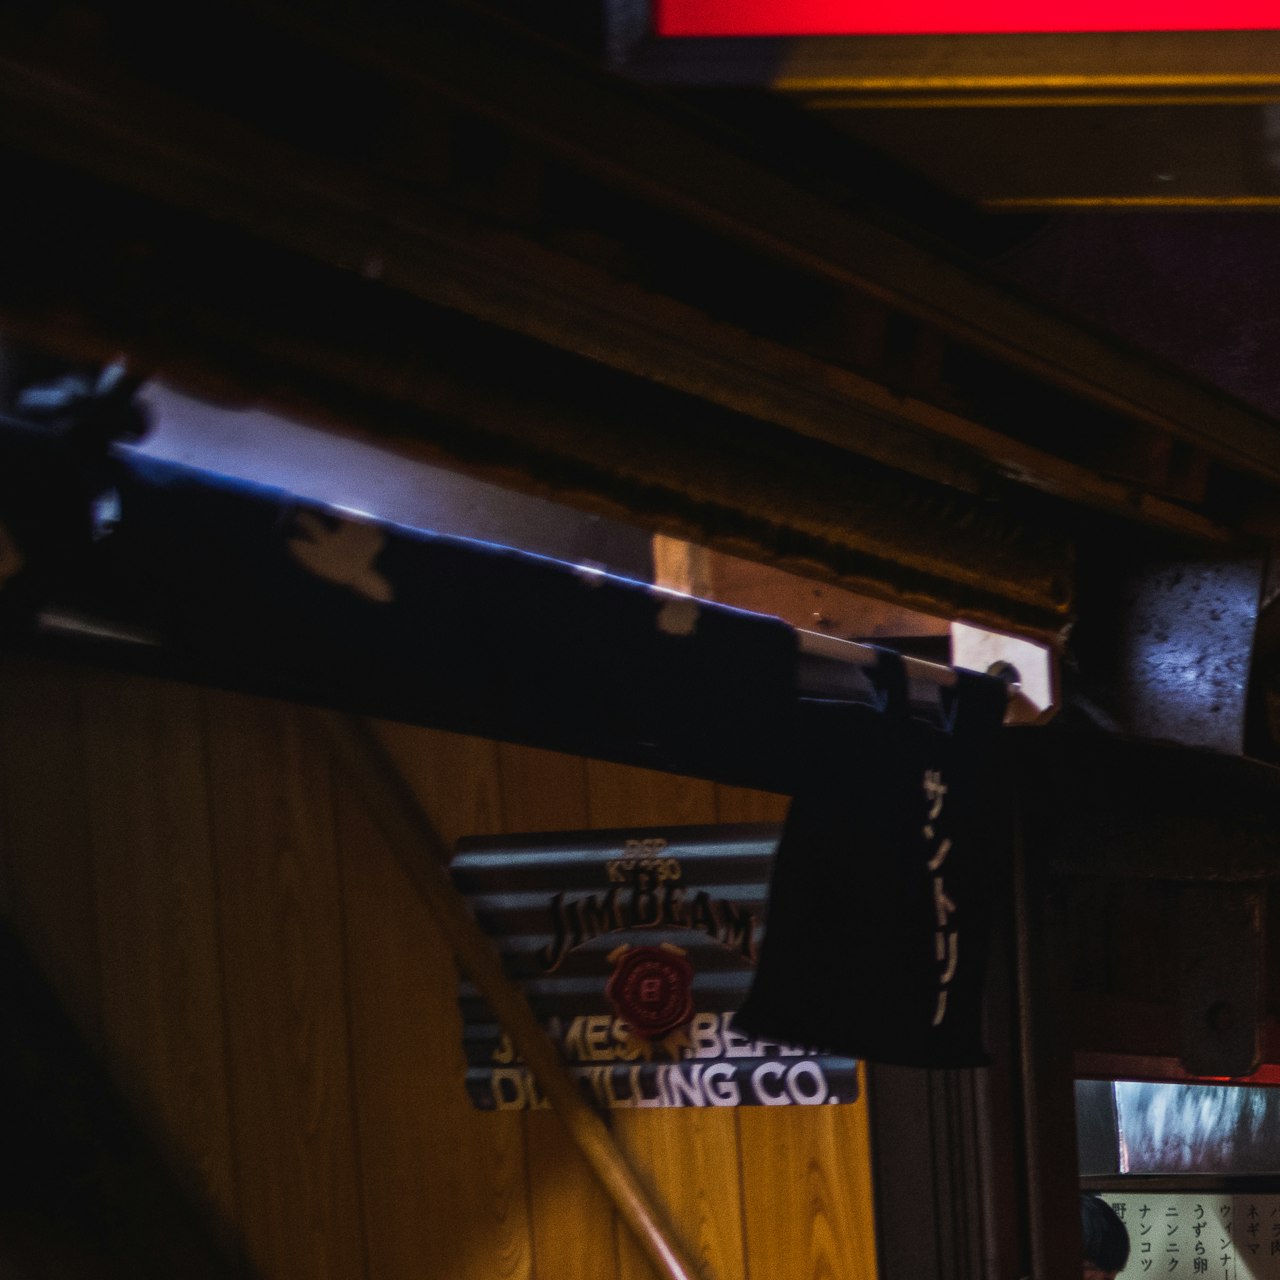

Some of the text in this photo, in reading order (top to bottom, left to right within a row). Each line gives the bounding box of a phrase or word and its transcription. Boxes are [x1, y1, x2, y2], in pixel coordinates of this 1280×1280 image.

[751, 1059, 840, 1106] CO.
[1138, 1203, 1153, 1273] ナンコツ
[1165, 1205, 1180, 1273] ニンニク
[1192, 1203, 1209, 1275] うずら卵
[1246, 1205, 1262, 1255] ネギマ
